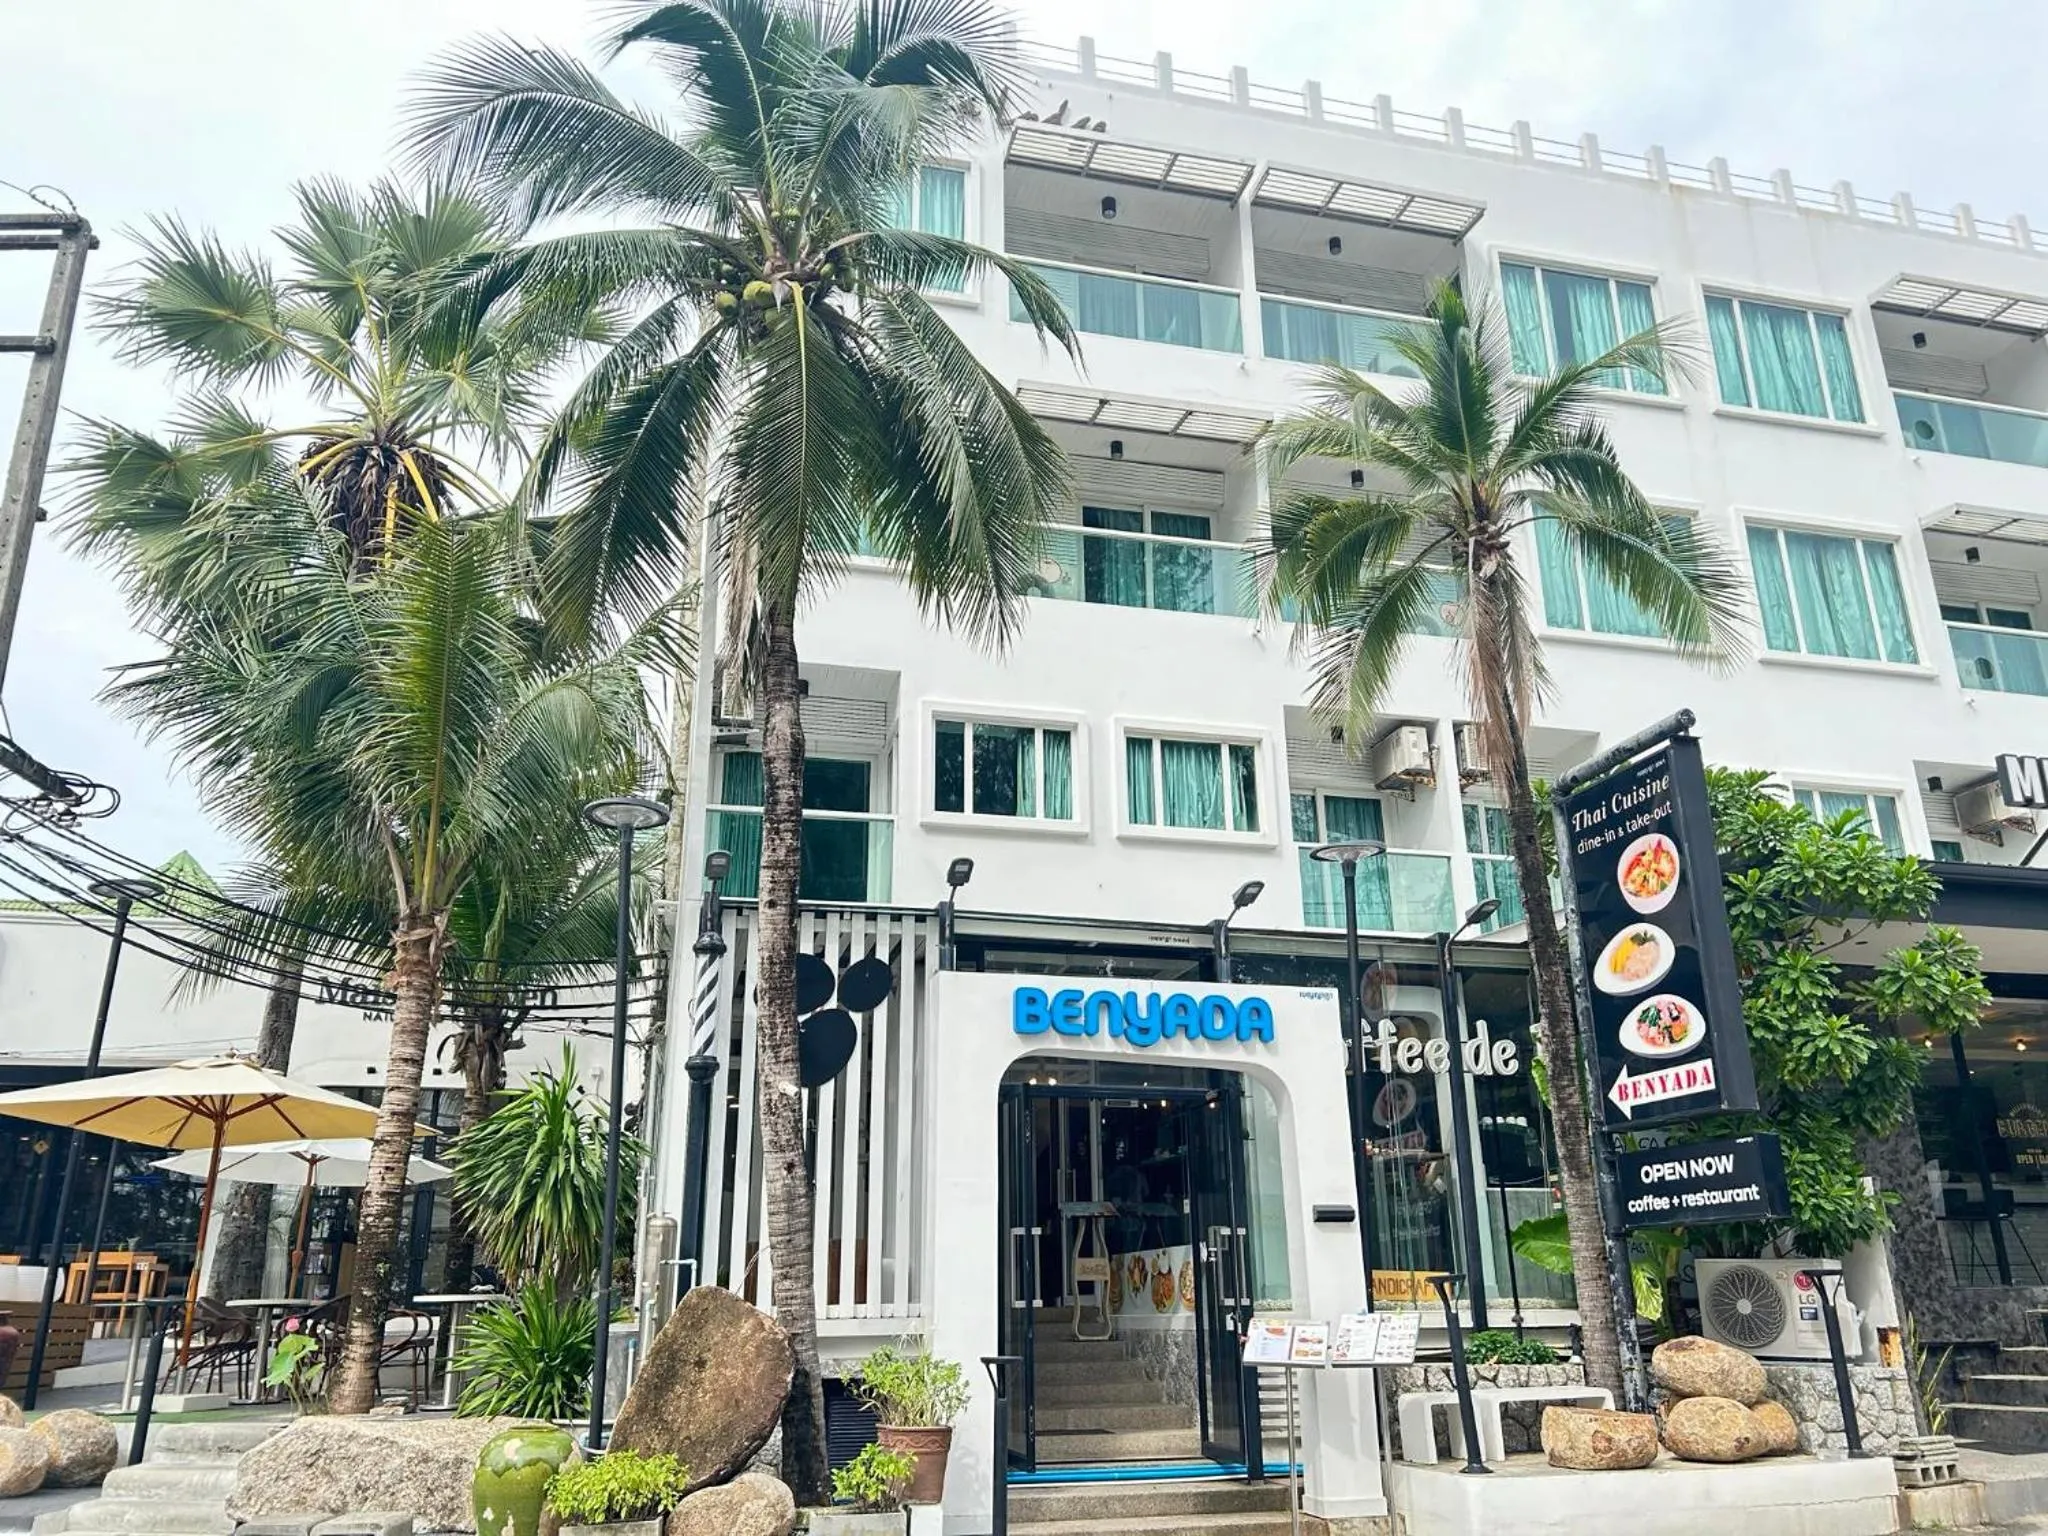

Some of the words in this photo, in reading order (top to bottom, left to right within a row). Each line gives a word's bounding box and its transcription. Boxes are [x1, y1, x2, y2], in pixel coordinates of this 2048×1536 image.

[1572, 801, 1607, 832] Thai
[1612, 775, 1669, 813] Cuisine
[1577, 829, 1616, 854] dine-in
[1626, 800, 1672, 833] take-out
[1465, 1019, 1519, 1076] de
[1617, 1066, 1712, 1102] BENYADA
[1640, 1158, 1688, 1184] OPEN
[1690, 1154, 1735, 1178] NOW
[1628, 1193, 1671, 1214] coffee
[1682, 1184, 1761, 1208] restaurant
[1799, 1294, 1816, 1305] LG
